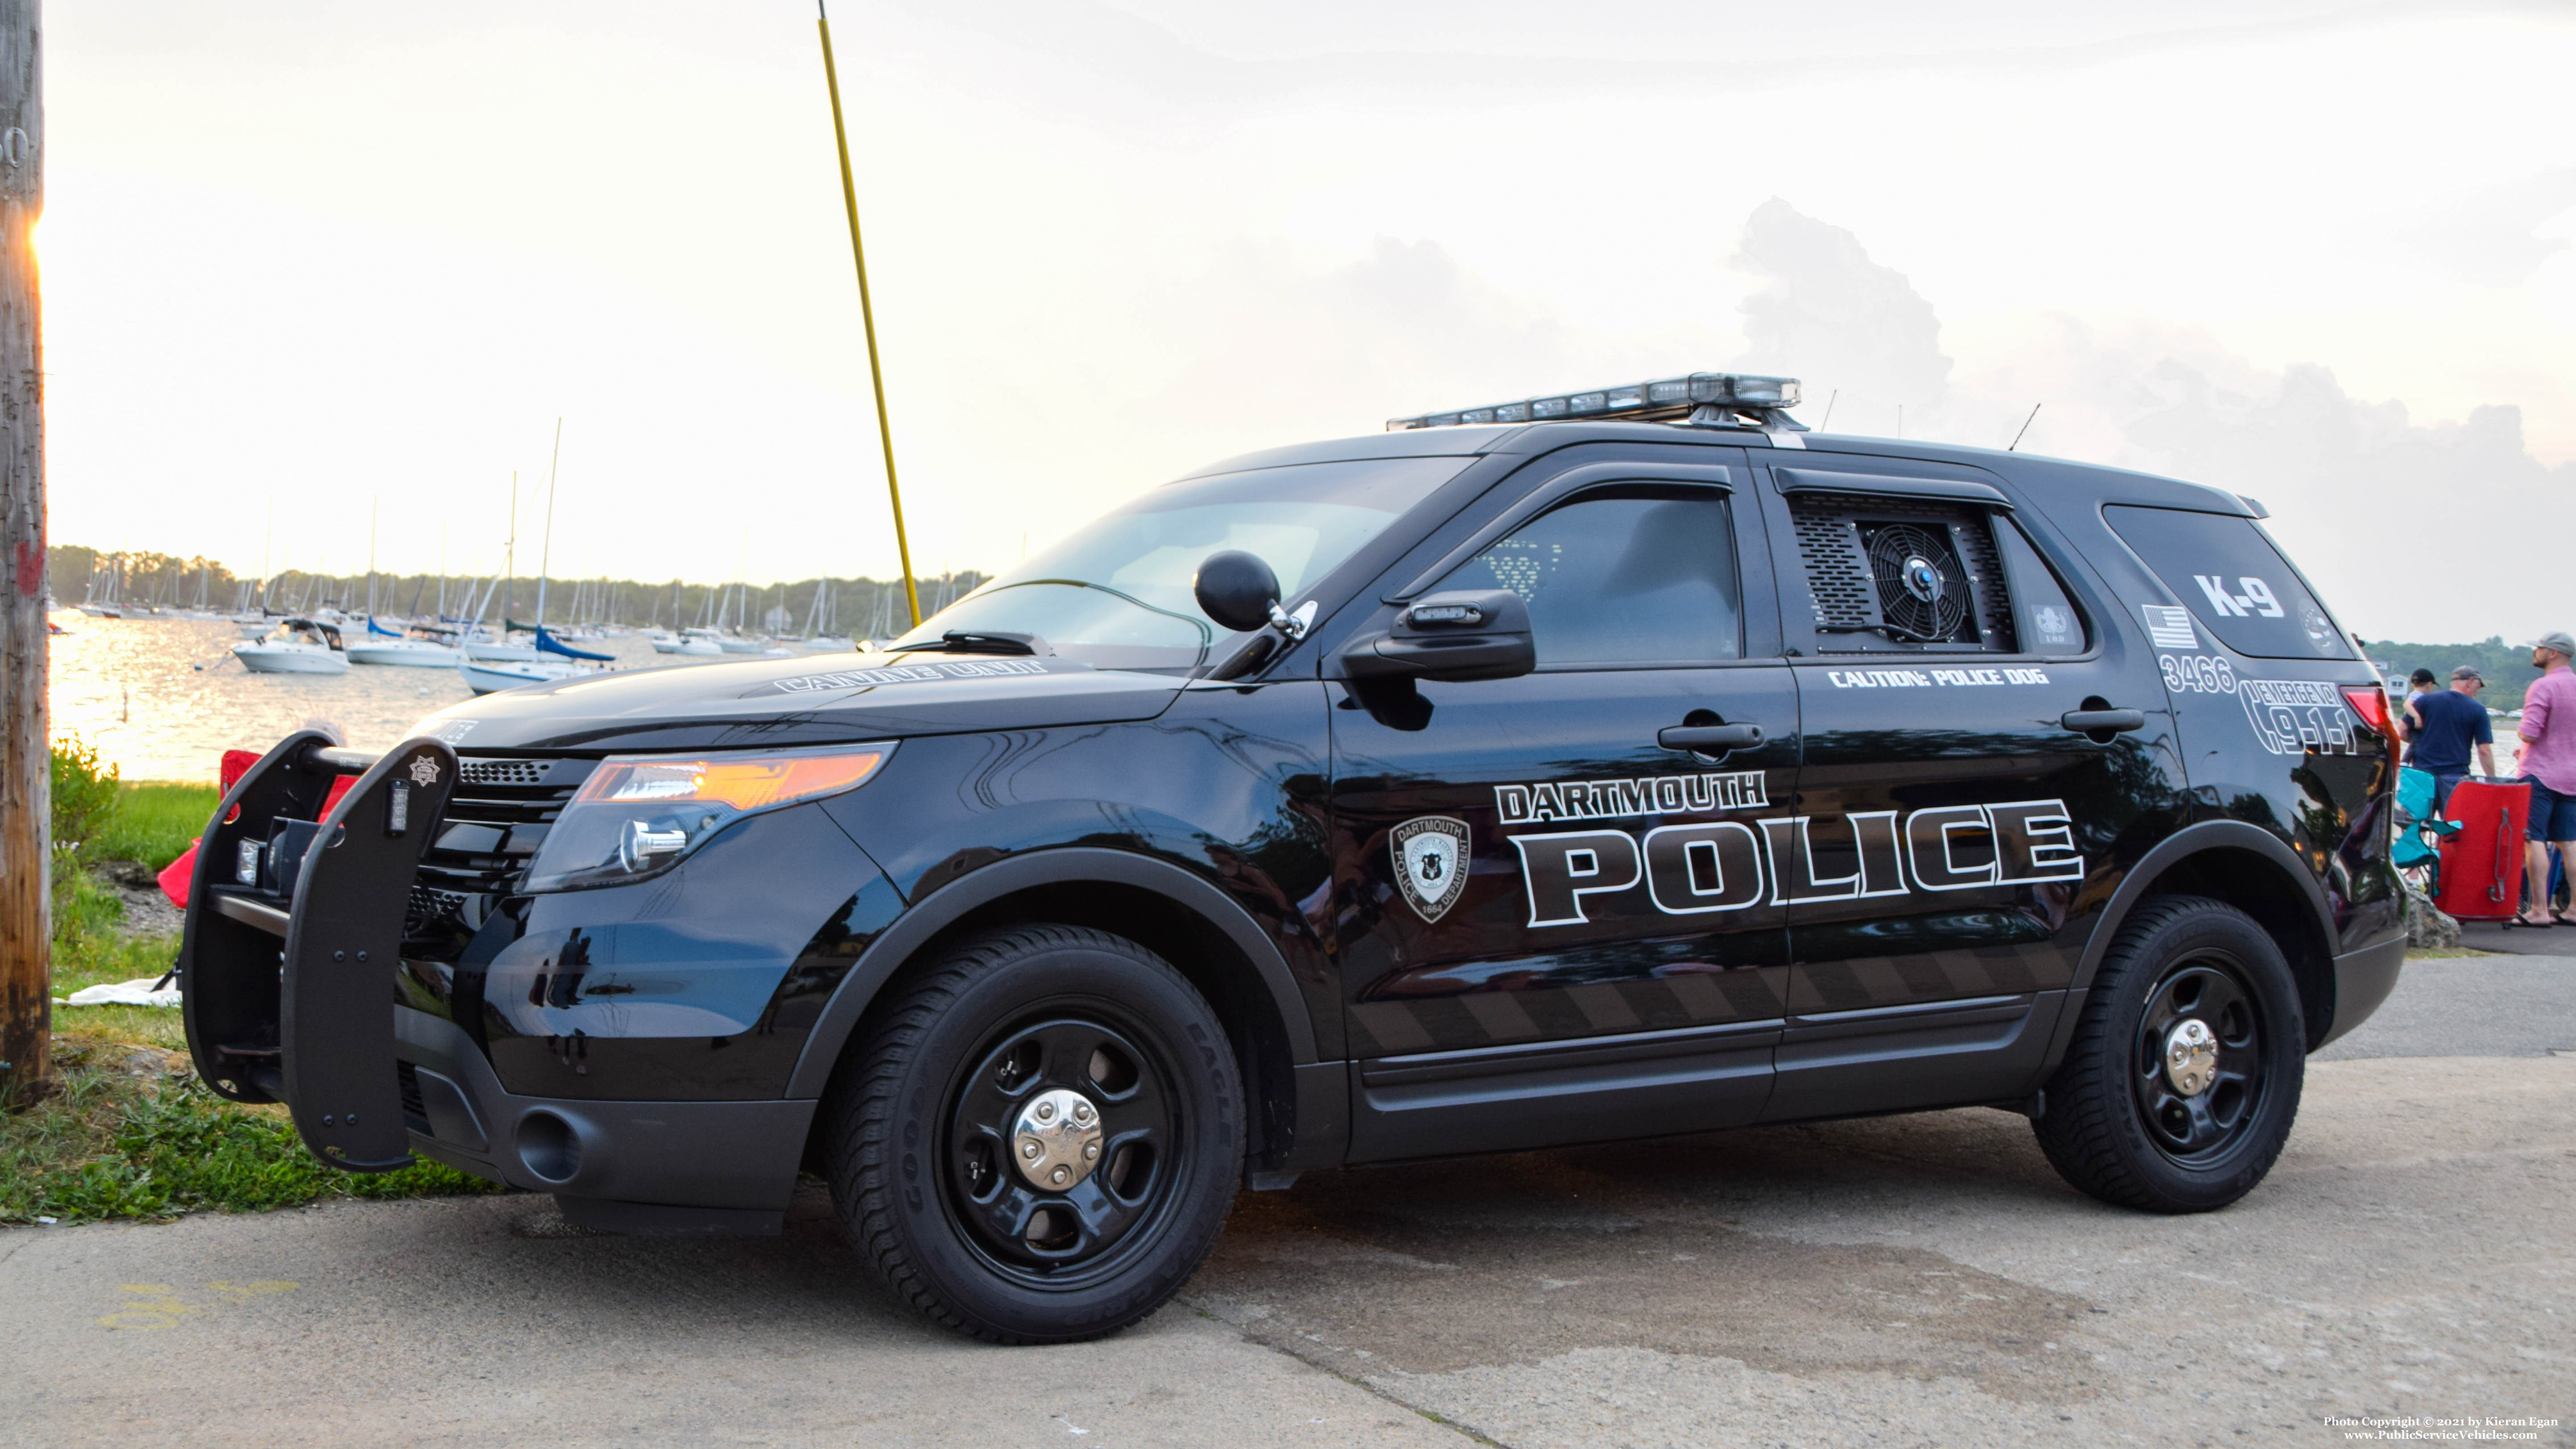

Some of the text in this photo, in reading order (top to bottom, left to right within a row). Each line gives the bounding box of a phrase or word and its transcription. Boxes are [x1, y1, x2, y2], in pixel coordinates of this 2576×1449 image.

[2193, 575, 2284, 617] K-9
[773, 660, 1049, 693] CANINE UNIT
[1829, 668, 2049, 687] CAUTION: POLICE DOG
[2160, 655, 2236, 694] 3466
[2253, 680, 2342, 707] EMERGENCY
[2269, 707, 2357, 755] 9-1-1
[1494, 770, 1769, 824] DARTMOUTH
[1398, 820, 1462, 842] DARTMOUTH
[1395, 851, 1420, 902] POLICE
[1441, 840, 1467, 905] DEPARTMENT
[1507, 799, 2085, 928] POLICE
[1423, 905, 1442, 914] 1664
[1187, 1022, 1232, 1147] EAGLE
